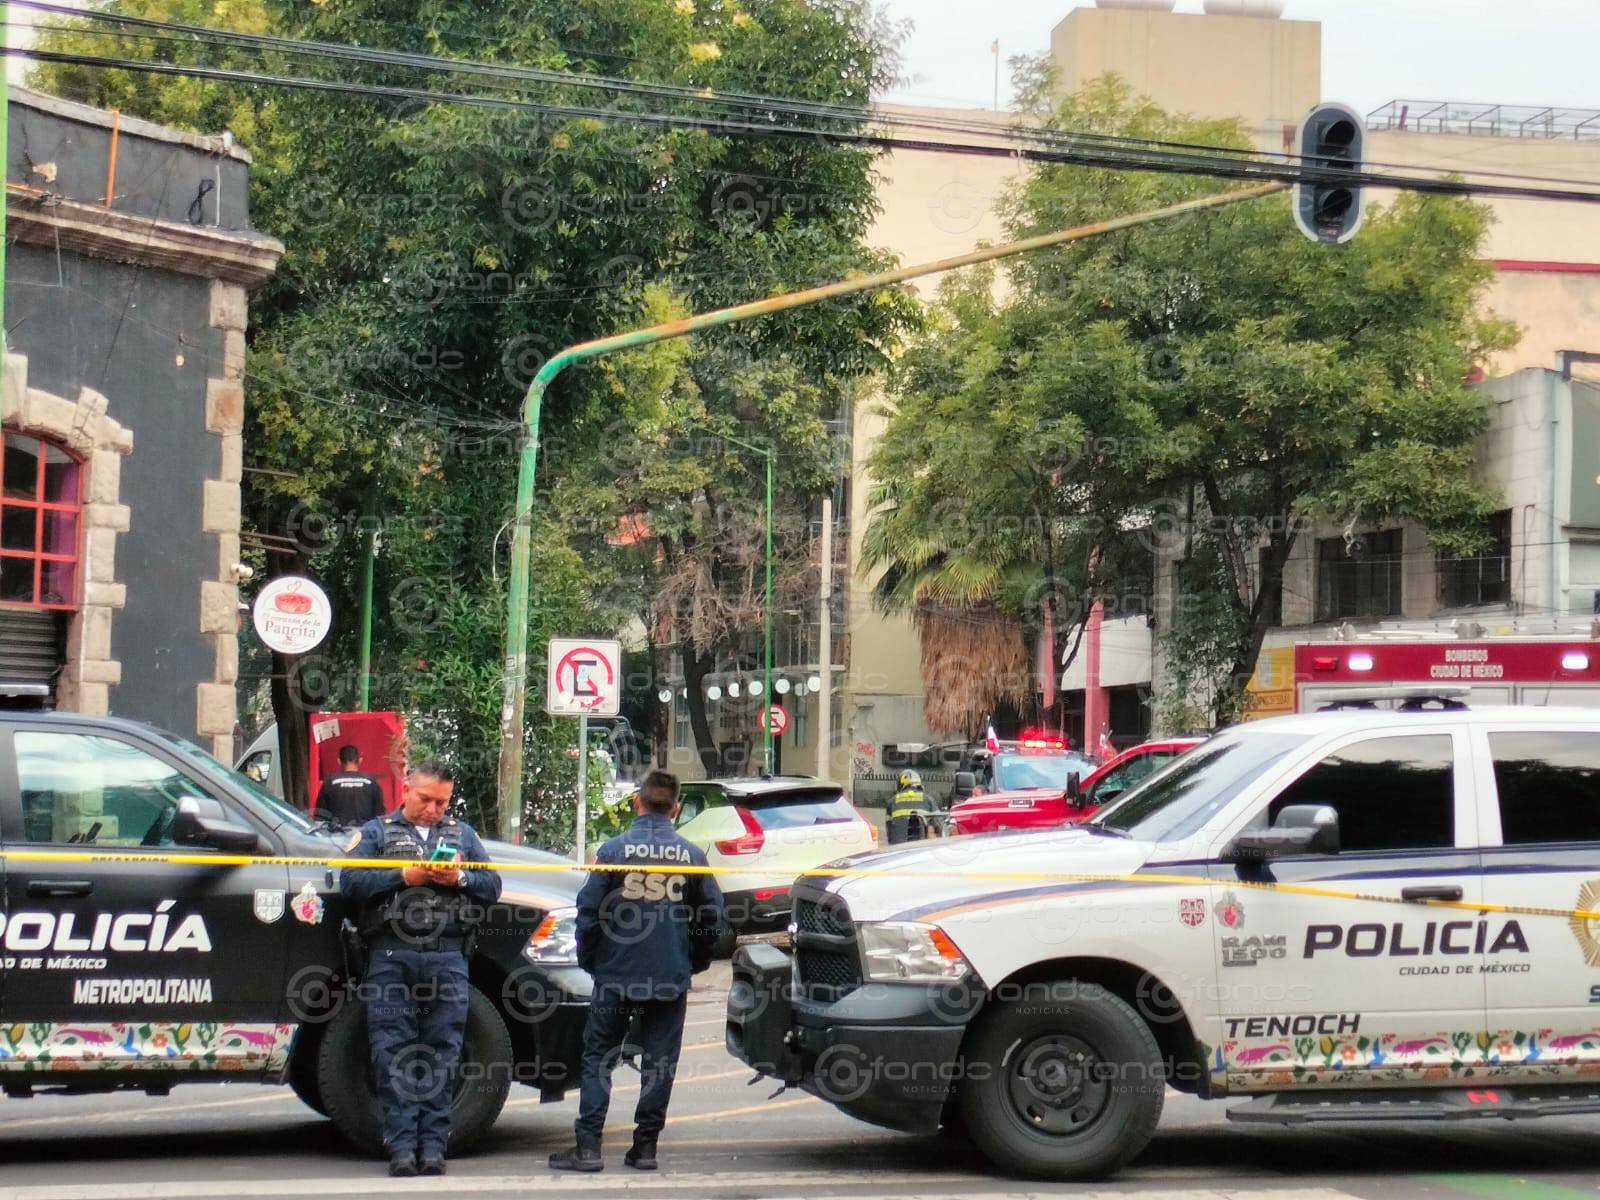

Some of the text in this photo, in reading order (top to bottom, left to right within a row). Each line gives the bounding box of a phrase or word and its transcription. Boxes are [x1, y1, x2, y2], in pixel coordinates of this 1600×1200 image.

[264, 620, 317, 638] Pancita
[1445, 649, 1488, 662] BOMBEROS
[1461, 665, 1472, 677] DE
[624, 843, 691, 864] POLICÍA
[622, 872, 687, 902] SSC
[0, 899, 213, 952] OLICÍA
[1303, 909, 1531, 959] POLICÍA
[1221, 935, 1287, 948] RAM
[21, 958, 43, 969] DE
[46, 955, 108, 970] MÉXICO
[1222, 947, 1287, 961] 1500
[1399, 960, 1531, 976] CIUDAD DE MÉXICO
[73, 979, 213, 1005] METROPOLITANA
[1225, 1014, 1360, 1039] TENOCH
